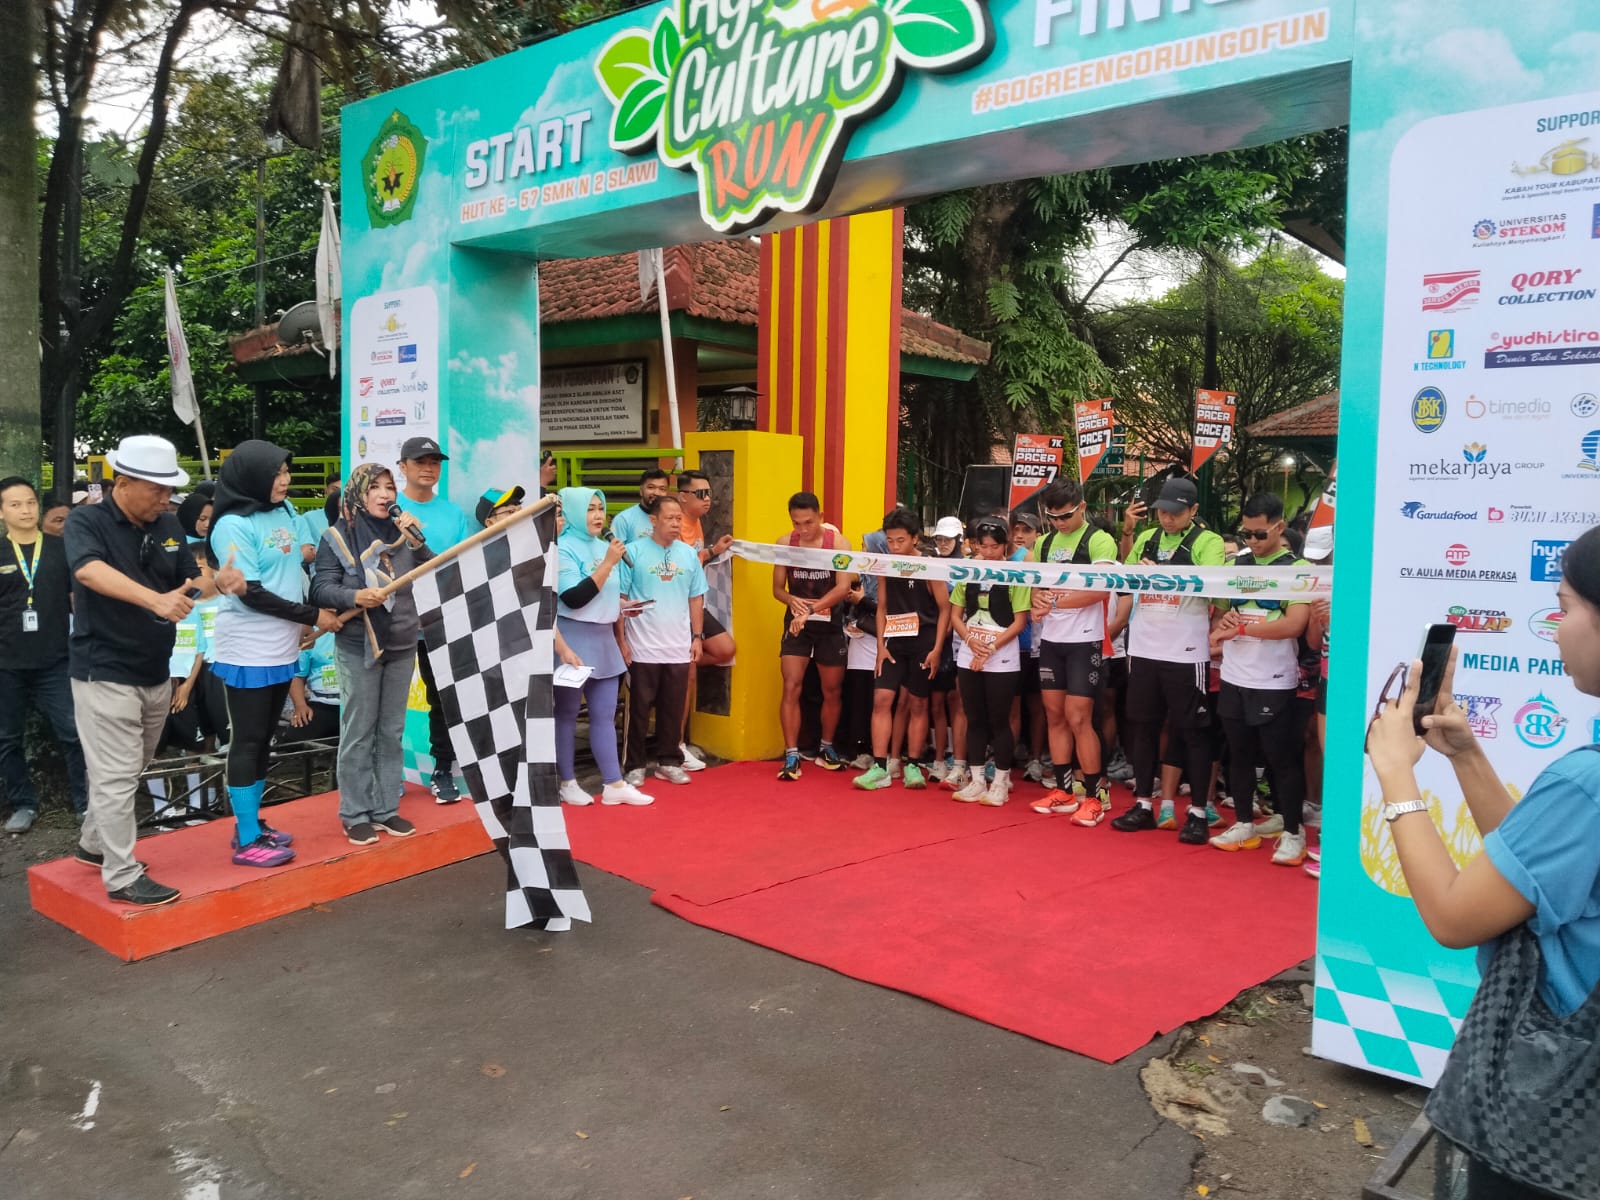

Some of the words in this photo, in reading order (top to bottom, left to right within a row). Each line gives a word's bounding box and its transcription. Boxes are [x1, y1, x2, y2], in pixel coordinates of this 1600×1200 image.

[974, 11, 1326, 113] #GOGREENGORUNGOFUN
[673, 15, 880, 142] Culture
[464, 109, 592, 190] START
[708, 111, 827, 209] RUN
[461, 200, 487, 222] HUT
[489, 197, 505, 217] KE
[520, 189, 538, 210] 57
[542, 181, 575, 203] SMK
[578, 180, 590, 197] N
[594, 174, 606, 193] 2
[607, 160, 658, 190] SLAWI
[1504, 184, 1534, 195] KABAH
[1535, 182, 1558, 191] TOUR
[1499, 213, 1567, 228] UNIVERSITAS
[1499, 222, 1566, 239] STEKOM
[1511, 268, 1582, 292] QORY
[1498, 288, 1597, 306] COLLECTION
[1502, 328, 1600, 350] yudhistira
[1421, 360, 1466, 371] TECHNOLOGY
[1531, 352, 1558, 362] Buku
[417, 380, 429, 393] bjb
[1197, 409, 1231, 422] PACER
[1078, 417, 1109, 432] PACER
[1195, 422, 1223, 437] PACE
[1221, 424, 1232, 443] 8
[1051, 438, 1063, 448] 7K
[1079, 430, 1104, 447] PACE
[1103, 428, 1112, 449] 7
[1015, 452, 1057, 463] PACER
[1514, 462, 1545, 470] GROUP
[1014, 464, 1047, 477] PACE
[1046, 465, 1058, 484] 7
[1409, 458, 1512, 480] mekarjaya
[1416, 510, 1479, 521] Garudafood
[1549, 511, 1600, 525] AKSAR
[949, 564, 1042, 585] START
[1078, 572, 1205, 593] FINISH
[1400, 567, 1414, 577] CV.
[1416, 567, 1444, 578] AULIA
[1445, 568, 1477, 580] MEDIA
[1478, 570, 1517, 581] PERKASA
[1468, 608, 1507, 617] SEPEDA
[1463, 652, 1520, 673] MEDIA
